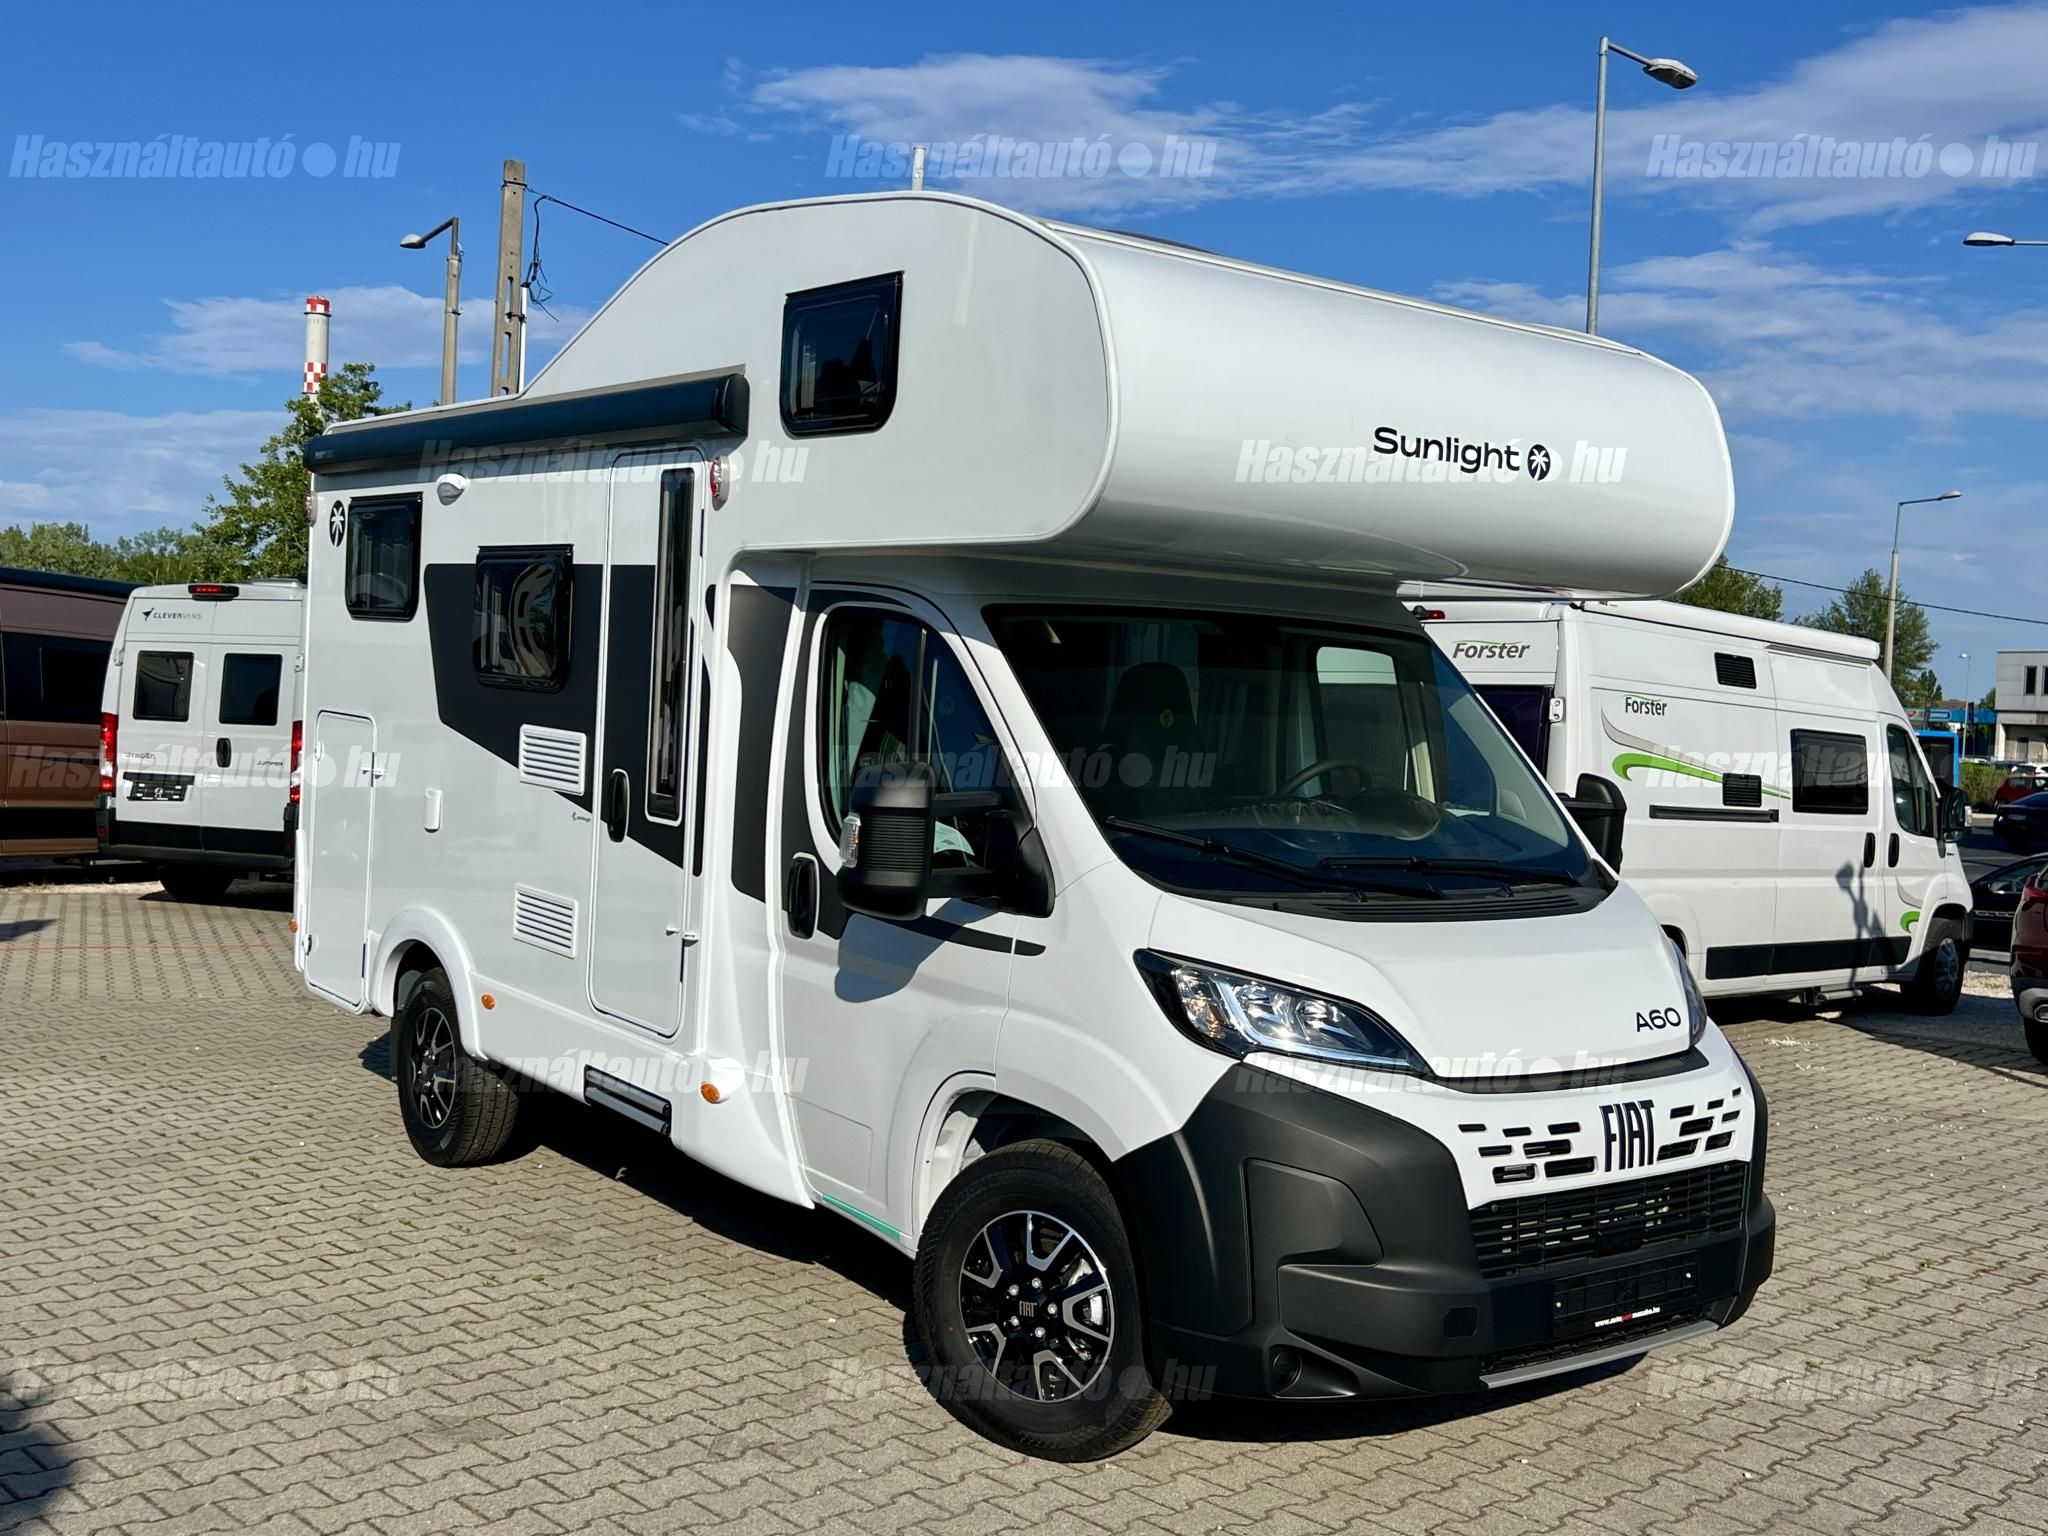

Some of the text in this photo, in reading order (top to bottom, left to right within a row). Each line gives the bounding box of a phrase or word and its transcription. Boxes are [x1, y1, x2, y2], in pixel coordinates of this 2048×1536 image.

[1373, 426, 1520, 474] Sunlight
[1452, 641, 1530, 659] Forster
[1625, 696, 1667, 716] Forster
[1635, 1007, 1682, 1032] A60
[1598, 1098, 1655, 1173] FIAT
[1019, 1300, 1038, 1317] FIAT
